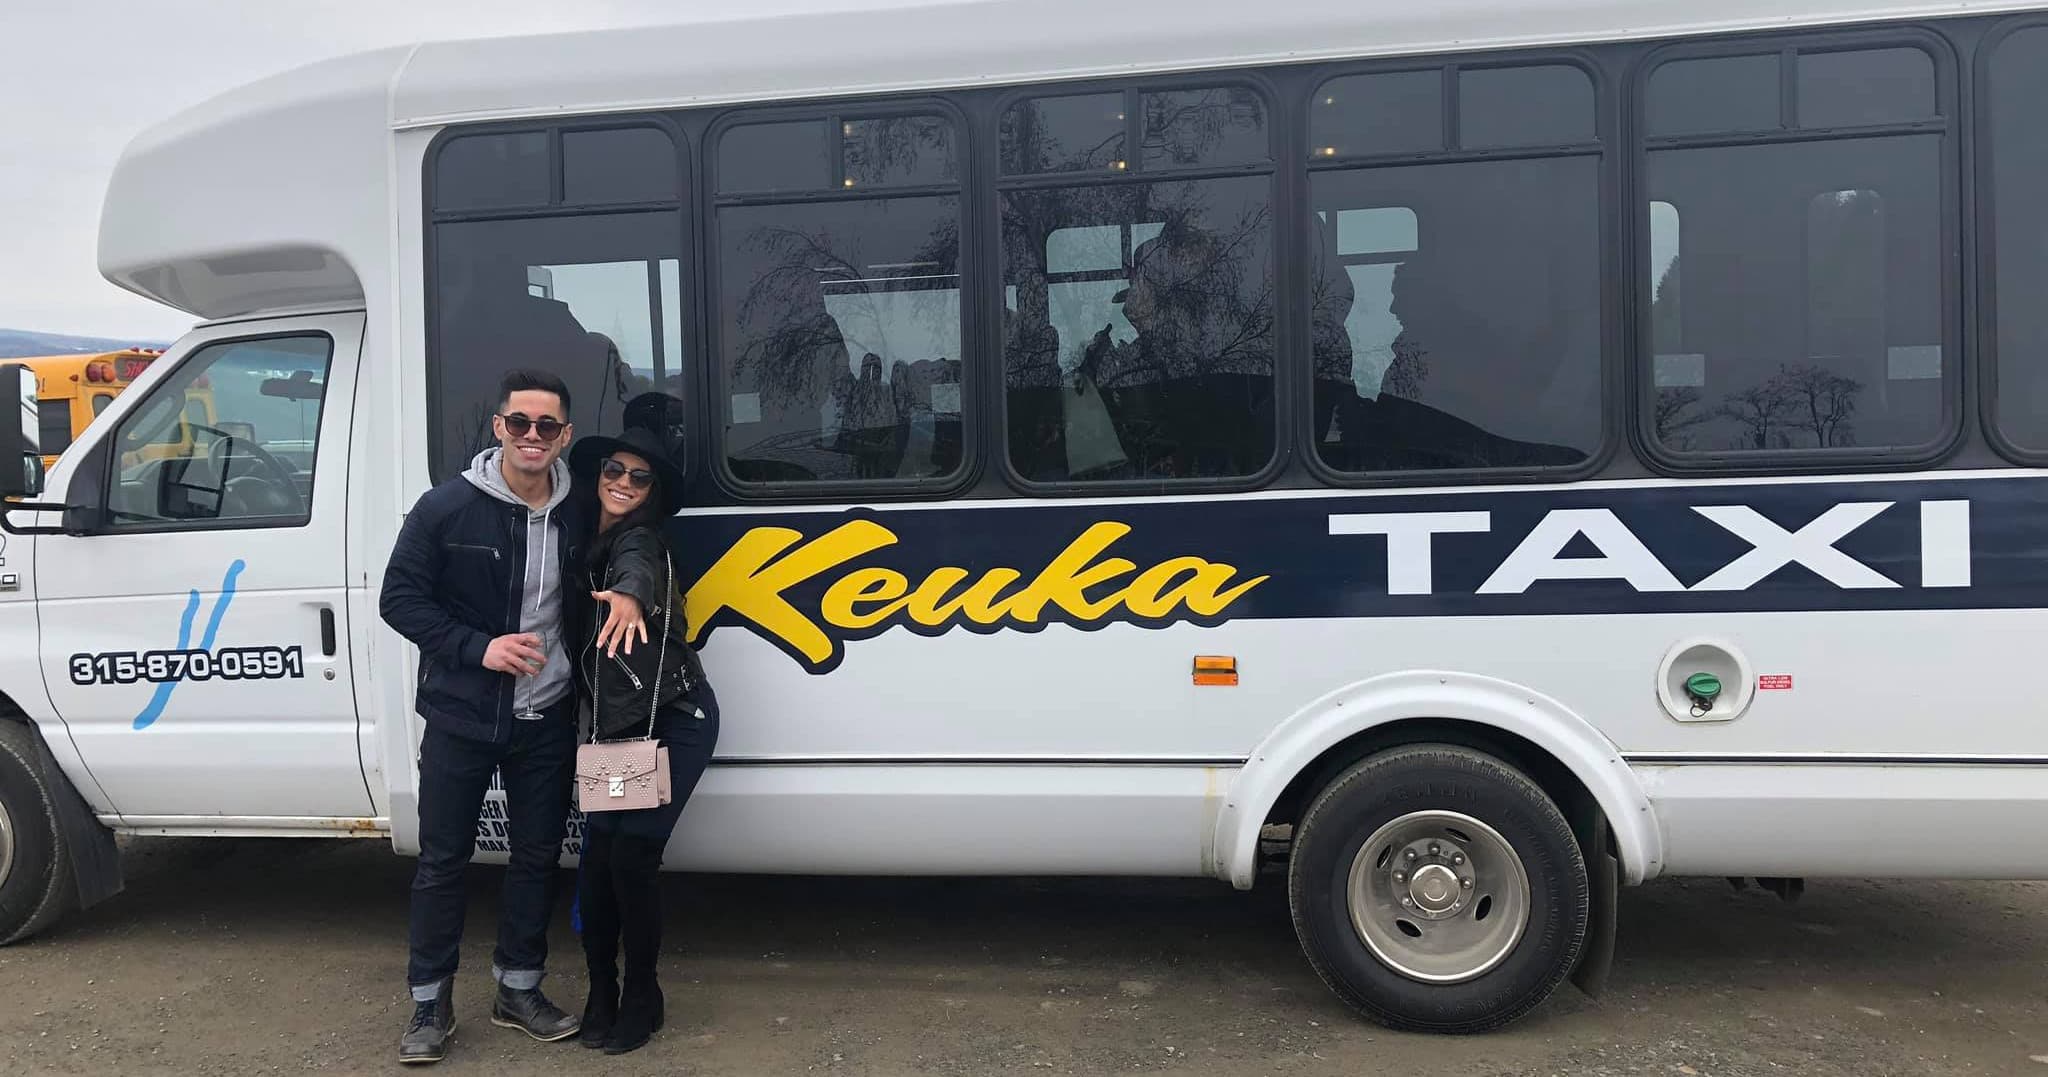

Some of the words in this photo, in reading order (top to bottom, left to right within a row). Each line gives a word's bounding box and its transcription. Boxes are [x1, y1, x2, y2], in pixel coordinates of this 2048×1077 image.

[685, 519, 1270, 663] Keuka
[1328, 500, 1971, 595] TAXI
[71, 649, 303, 683] 315-870-0591
